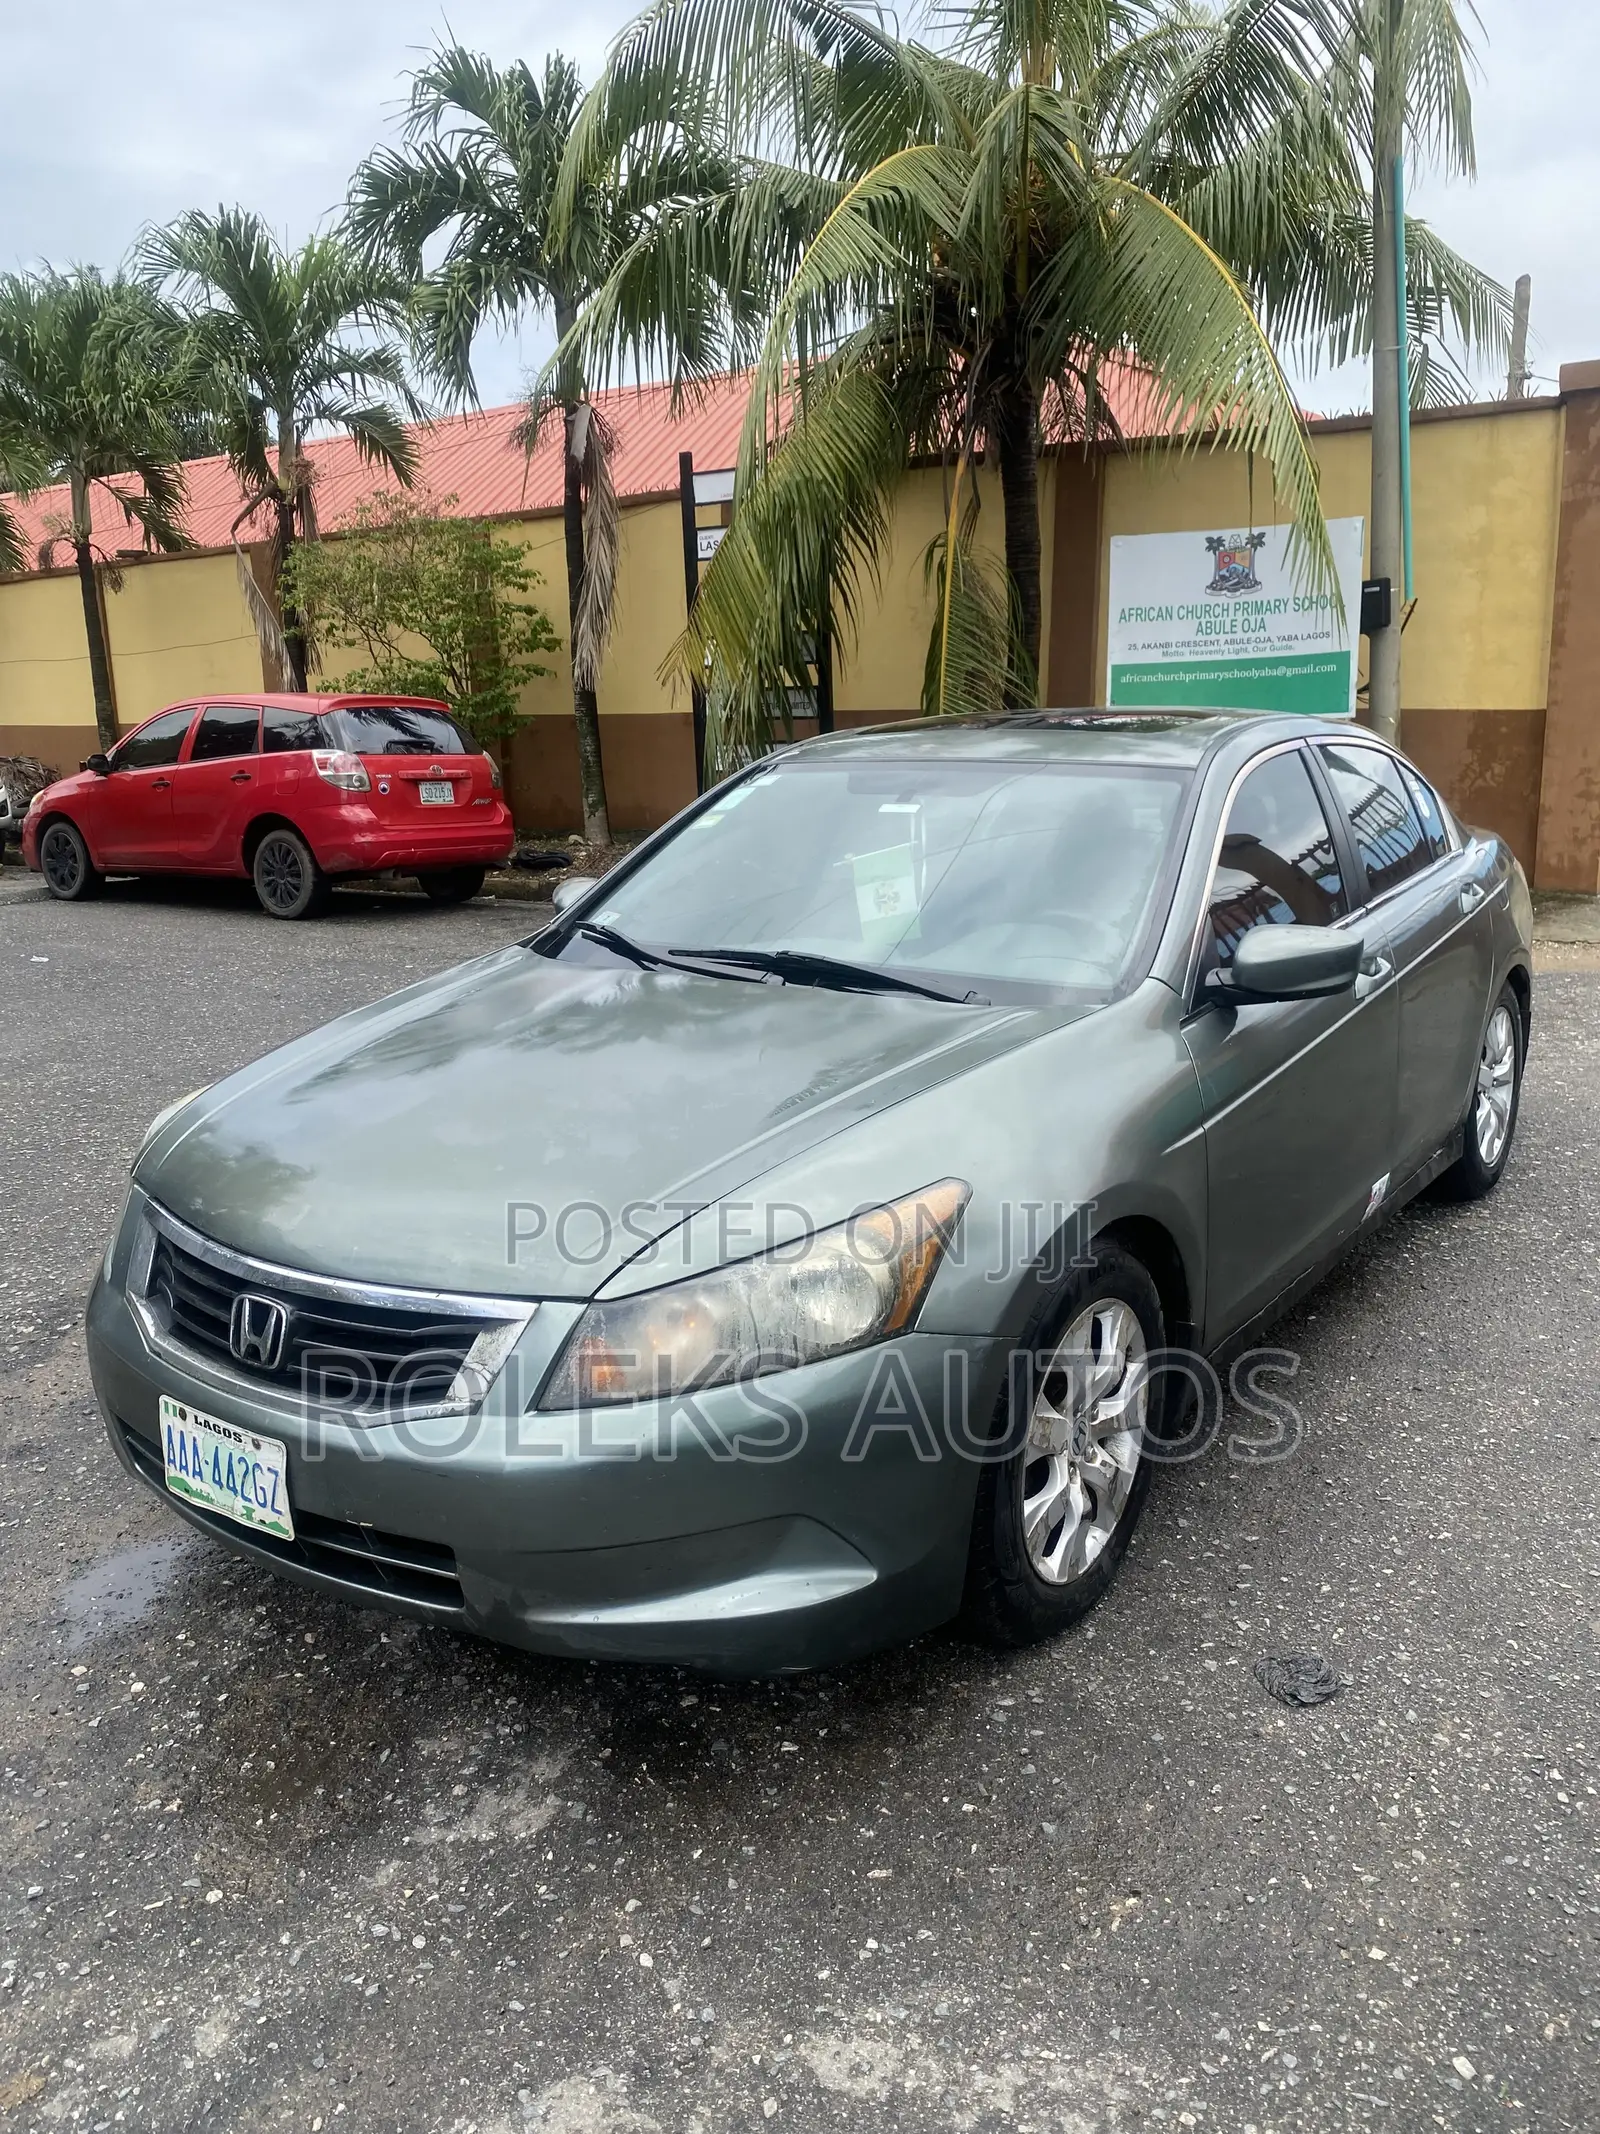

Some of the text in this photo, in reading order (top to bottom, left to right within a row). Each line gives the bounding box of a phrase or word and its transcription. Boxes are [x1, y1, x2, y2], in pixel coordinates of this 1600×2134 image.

[700, 539, 720, 551] LAS
[1118, 593, 1345, 624] AFRICAN CHURCH PRIMARY SCHOO
[1195, 616, 1267, 637] ABULE OJA
[1127, 631, 1331, 651] 25, AKANBI CRESCENT, ABULE-OJA, YABA LAGOS
[1189, 645, 1225, 657] Heavenly
[1252, 644, 1268, 653] Our
[1120, 663, 1337, 683] africanchurchprimaryschoolyaba@gmail.com
[194, 1414, 243, 1443] LAGOS
[166, 1424, 283, 1516] AAA-442GZ
